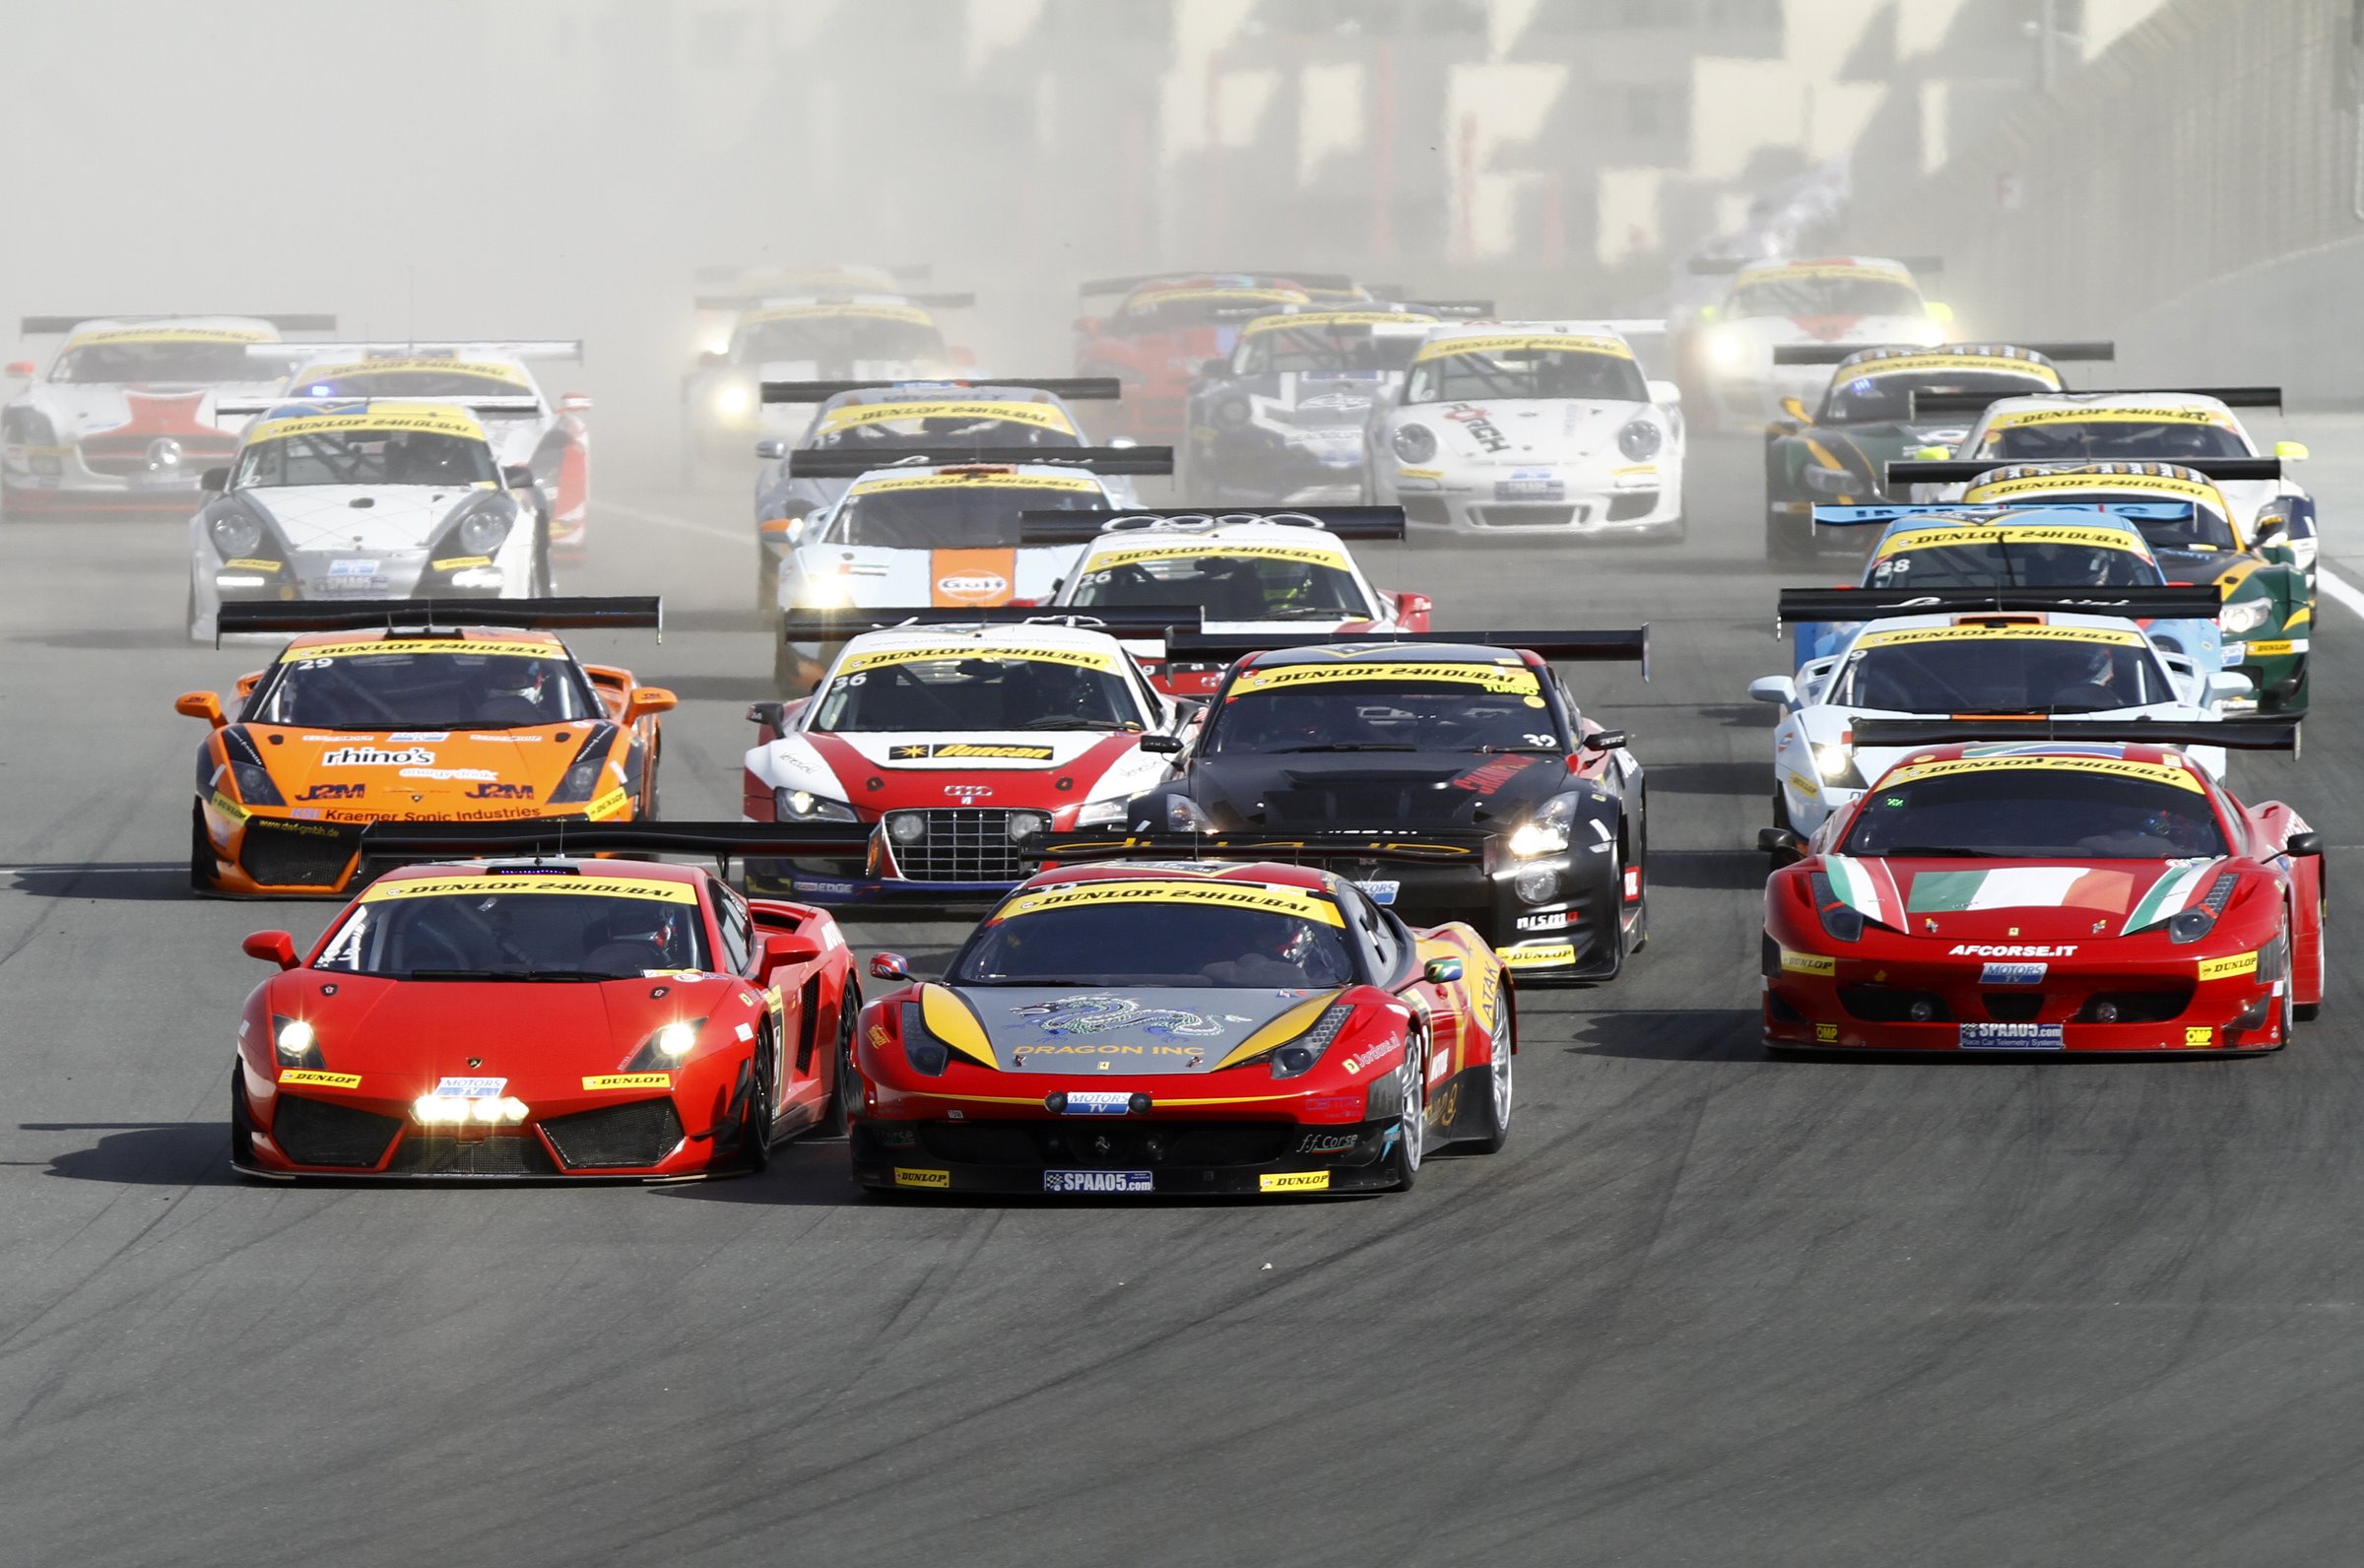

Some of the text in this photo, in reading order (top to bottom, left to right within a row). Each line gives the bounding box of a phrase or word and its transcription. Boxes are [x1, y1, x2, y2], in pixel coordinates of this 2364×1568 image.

[862, 406, 946, 421] DUNLOP
[2021, 408, 2107, 423] DUNLOP
[283, 419, 367, 431] DUNLOP
[2000, 480, 2091, 493] DUNLOP
[1912, 532, 2011, 545] DUNLOP
[1117, 546, 1214, 561] DUNLOP
[1892, 629, 1997, 641] DUNLOP
[320, 643, 422, 654] DUNLOP
[870, 648, 973, 664] DUNLOP
[297, 657, 333, 671] 29
[832, 672, 867, 690] 36
[1274, 668, 1382, 683] DUNLOP
[1482, 683, 1539, 695] TURBO
[326, 749, 431, 763] rhino's
[933, 744, 1052, 757] Duncan
[1928, 757, 2044, 774] DUNLOP
[325, 809, 398, 821] Kraemer
[404, 811, 452, 821] Sonic
[456, 806, 542, 820] Industries
[408, 882, 530, 893] DUNLOP
[819, 882, 853, 893] EDGE
[1041, 889, 1163, 906] DUNLOP
[1516, 911, 1580, 929] nismo
[1512, 949, 1571, 961] DUNLOP
[1948, 945, 2078, 957] AFCORSE.IT
[1789, 956, 1833, 970] DUNLOP
[2213, 957, 2256, 972] DUNLOP
[1987, 964, 2044, 975] MOTORS
[1816, 1026, 1837, 1037] OMP
[2186, 1030, 2212, 1042] OMP
[1997, 1038, 2030, 1047] Telemetry
[2032, 1038, 2061, 1047] Systems
[1012, 1044, 1206, 1056] DRAGON INC
[296, 1073, 358, 1084] DUNLOP
[444, 1078, 501, 1088] MOTORS
[600, 1076, 666, 1085] DUNLOP
[1070, 1093, 1129, 1103] MOTORS
[1088, 1103, 1108, 1112] TV
[901, 1172, 947, 1183] DUNLOP
[1064, 1173, 1151, 1191] SPAA05.com
[1276, 1175, 1329, 1186] DUNLOP
